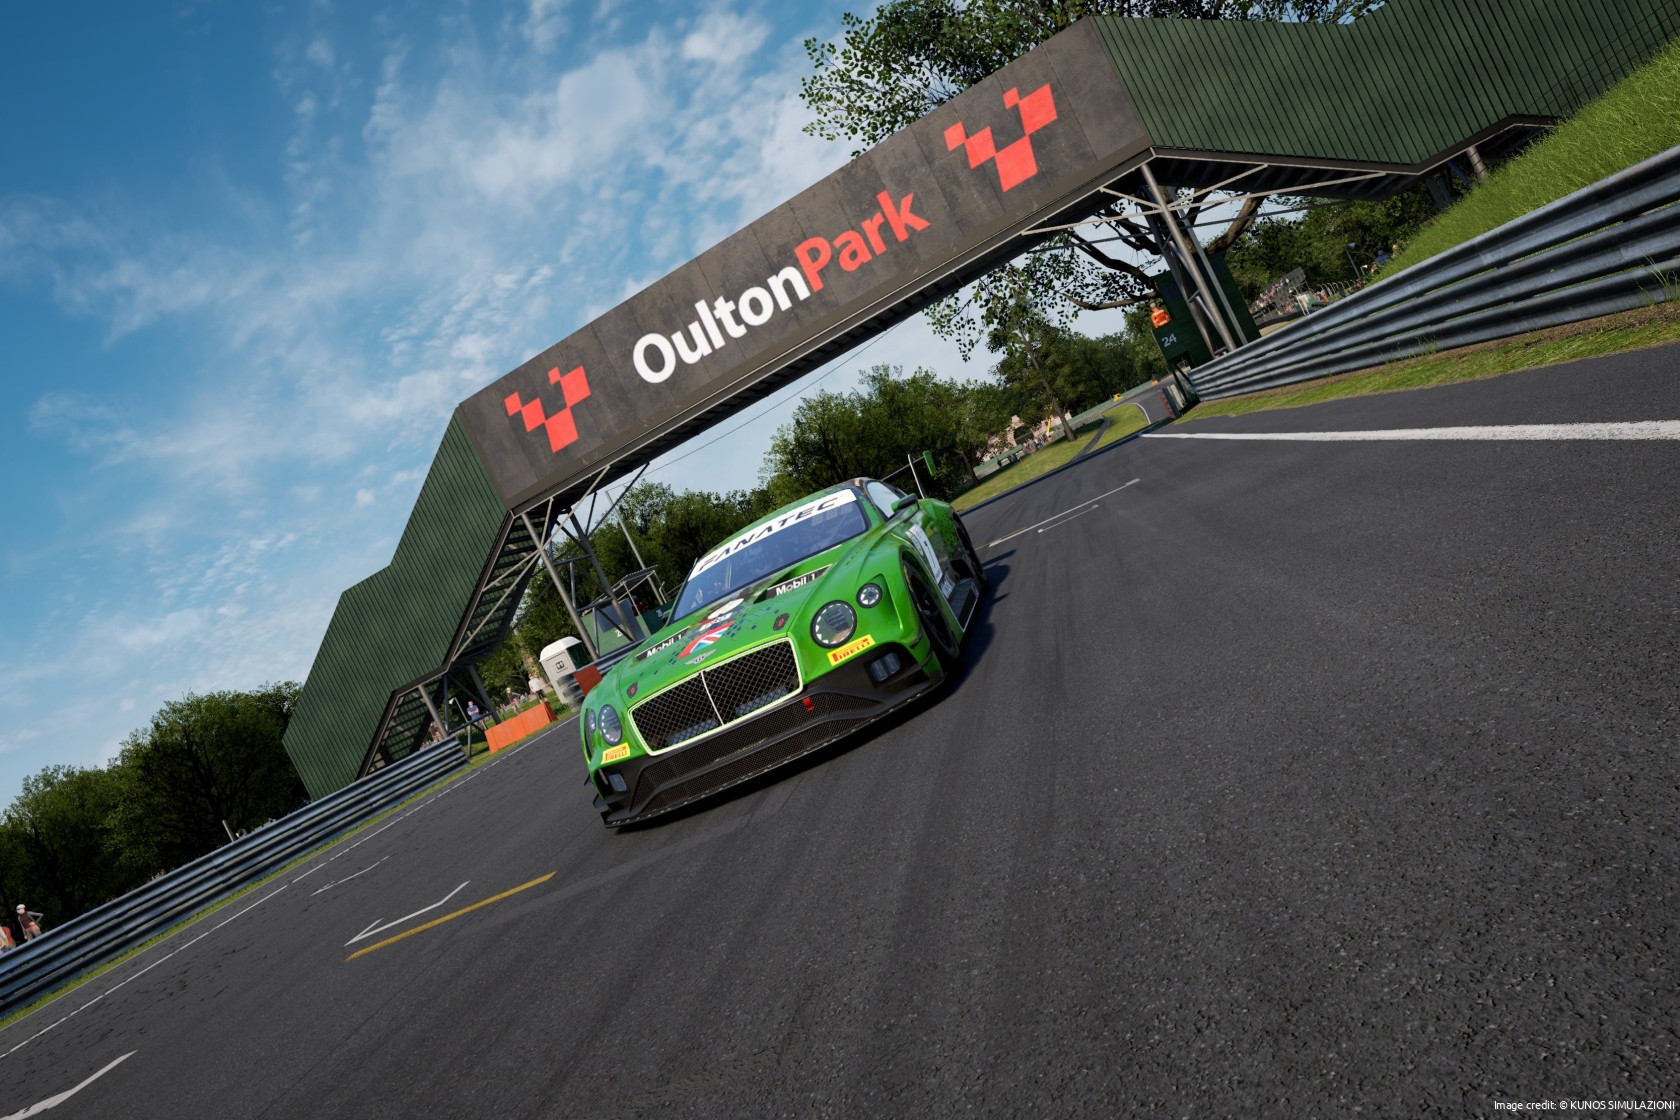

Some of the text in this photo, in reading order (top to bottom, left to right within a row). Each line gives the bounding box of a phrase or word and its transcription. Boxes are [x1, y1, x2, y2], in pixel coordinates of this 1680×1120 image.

[632, 189, 932, 384] OultonPark
[1161, 333, 1177, 347] 24
[698, 496, 839, 572] FANATEC
[775, 573, 816, 596] Mobil 1
[646, 637, 675, 658] Mobil
[832, 637, 871, 662] PIRELLI
